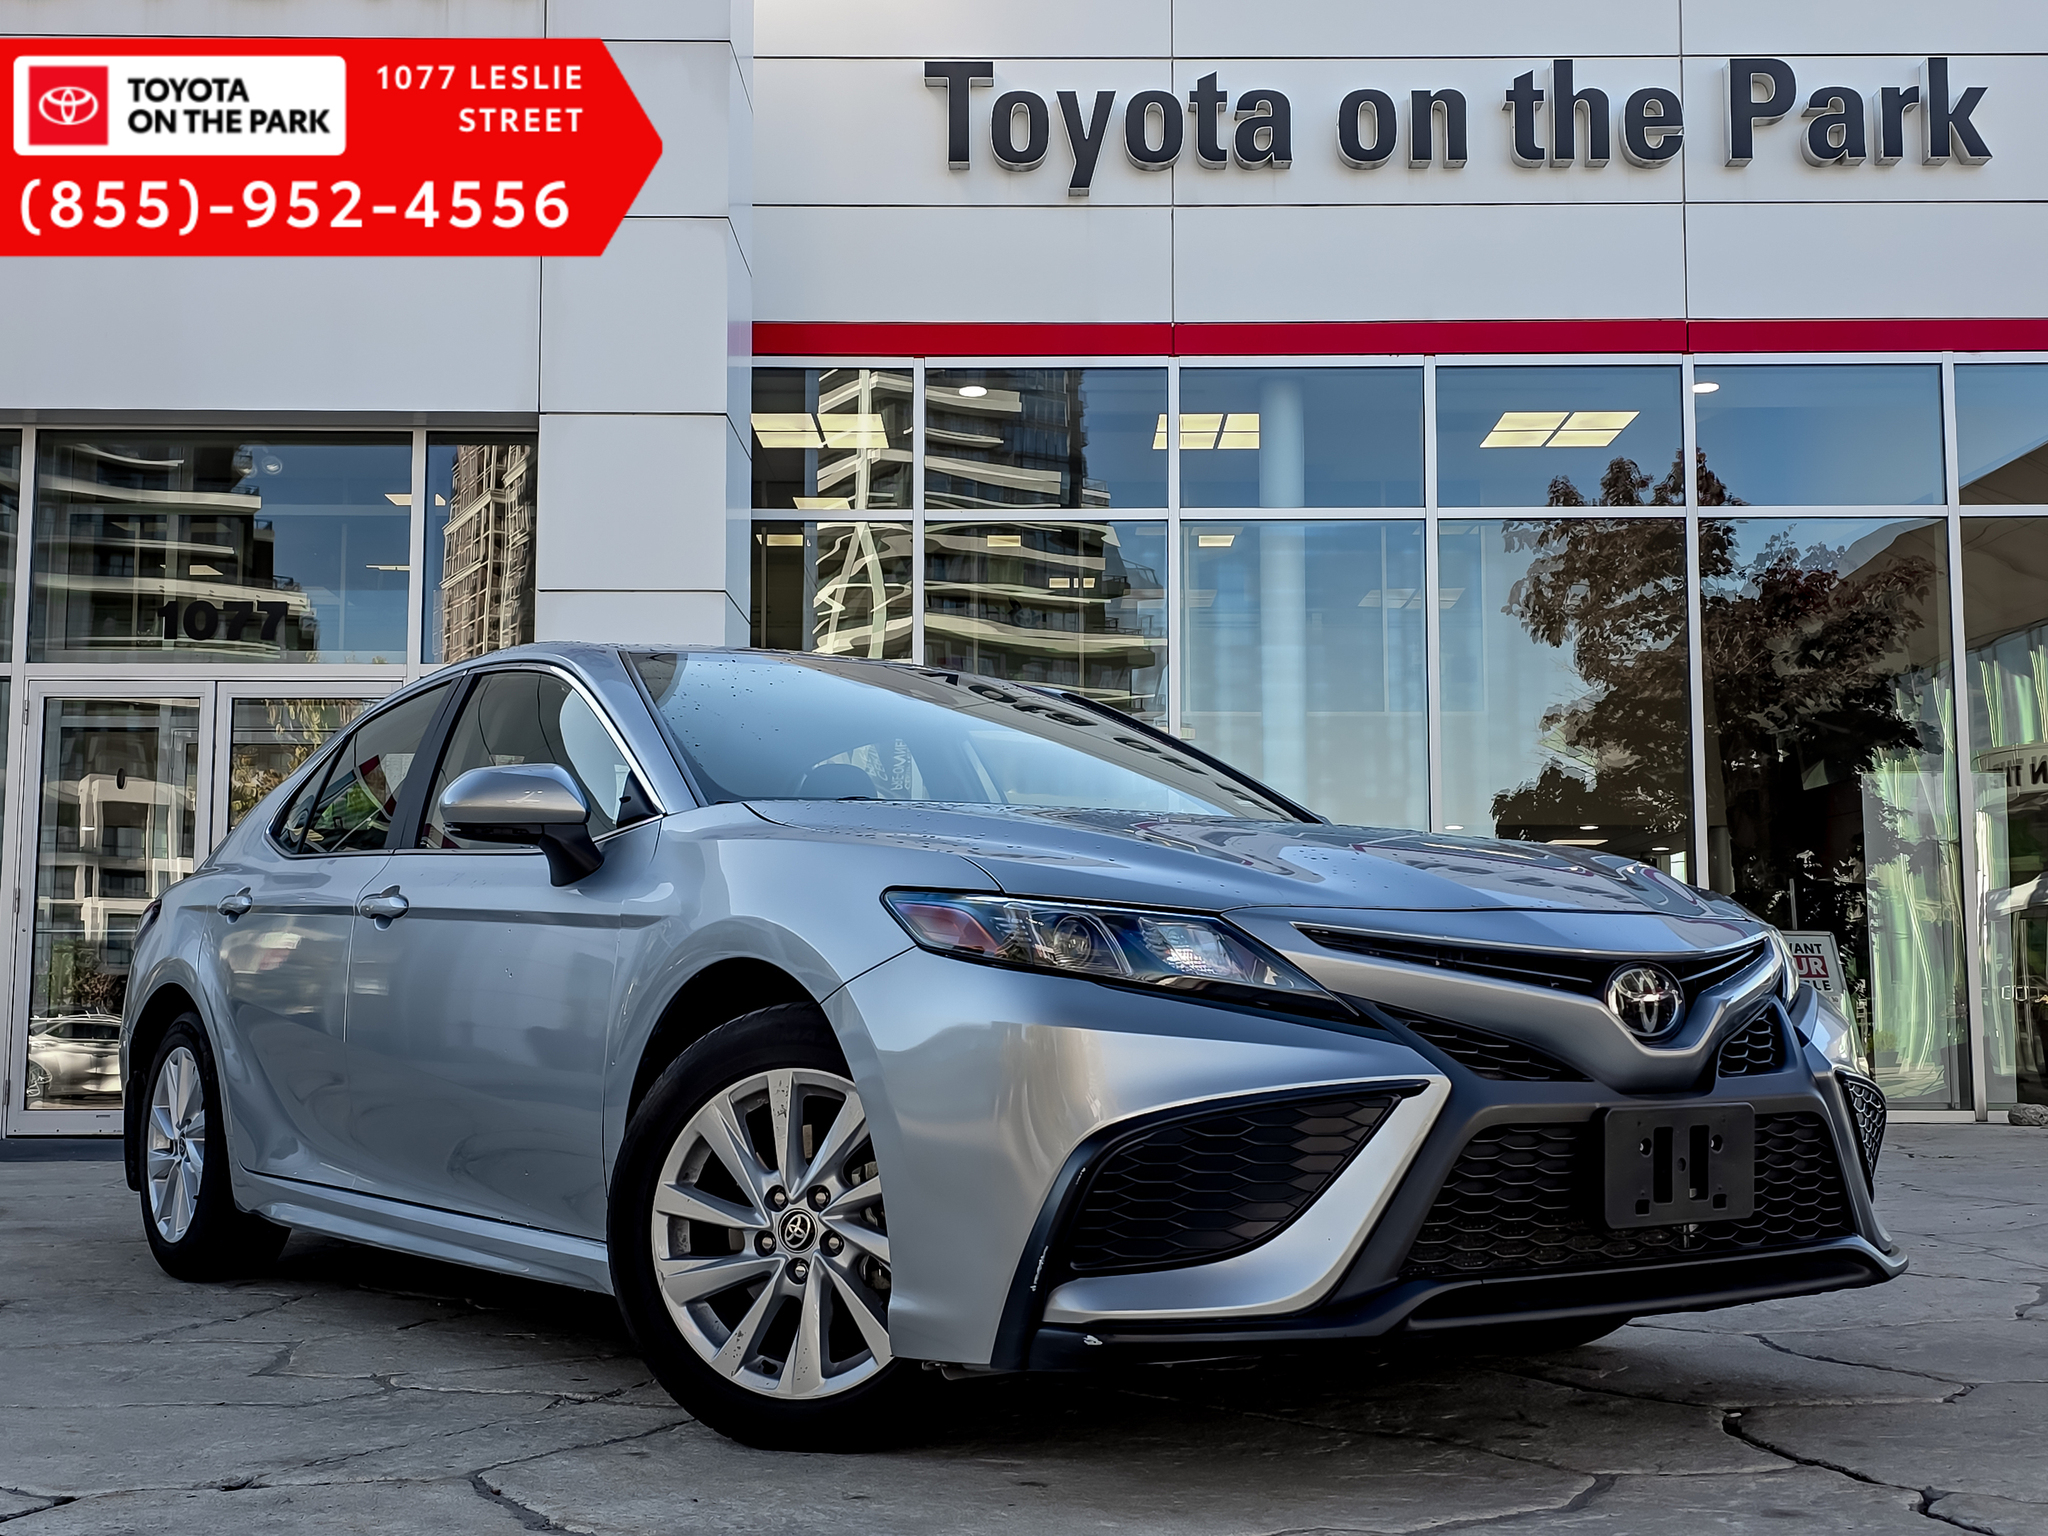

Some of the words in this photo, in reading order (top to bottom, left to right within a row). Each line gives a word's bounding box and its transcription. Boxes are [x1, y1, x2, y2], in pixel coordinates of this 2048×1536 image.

[923, 61, 1292, 197] Toyota
[1336, 87, 1469, 170] on
[1502, 59, 1685, 169] the
[1722, 57, 1993, 168] Park
[157, 600, 289, 641] 1077
